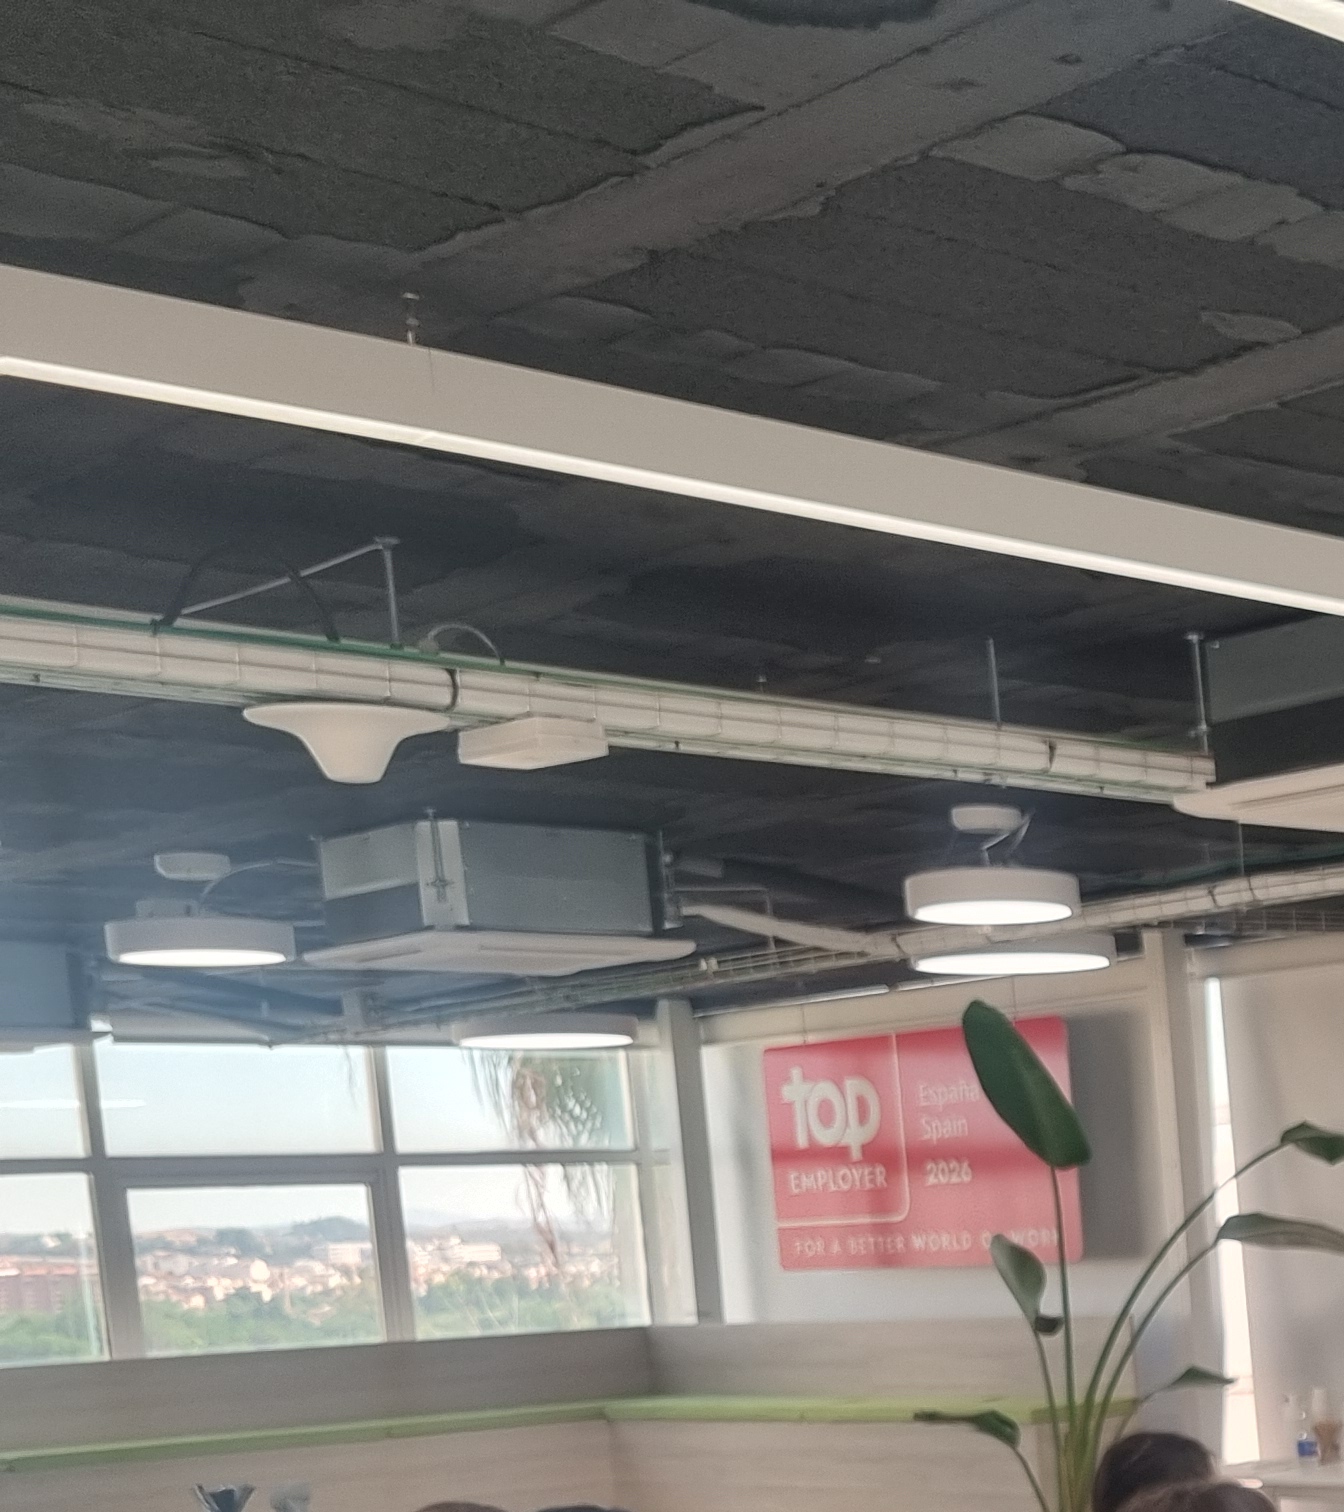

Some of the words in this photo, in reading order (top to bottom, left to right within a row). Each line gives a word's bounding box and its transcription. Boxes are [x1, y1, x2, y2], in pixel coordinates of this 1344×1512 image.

[780, 1066, 882, 1162] top
[920, 1115, 969, 1144] Spain
[789, 1166, 888, 1195] EMPLOYER
[925, 1160, 974, 1187] 2026
[795, 1239, 826, 1257] FOR
[850, 1235, 905, 1256] BETTER
[911, 1232, 972, 1251] WORLD
